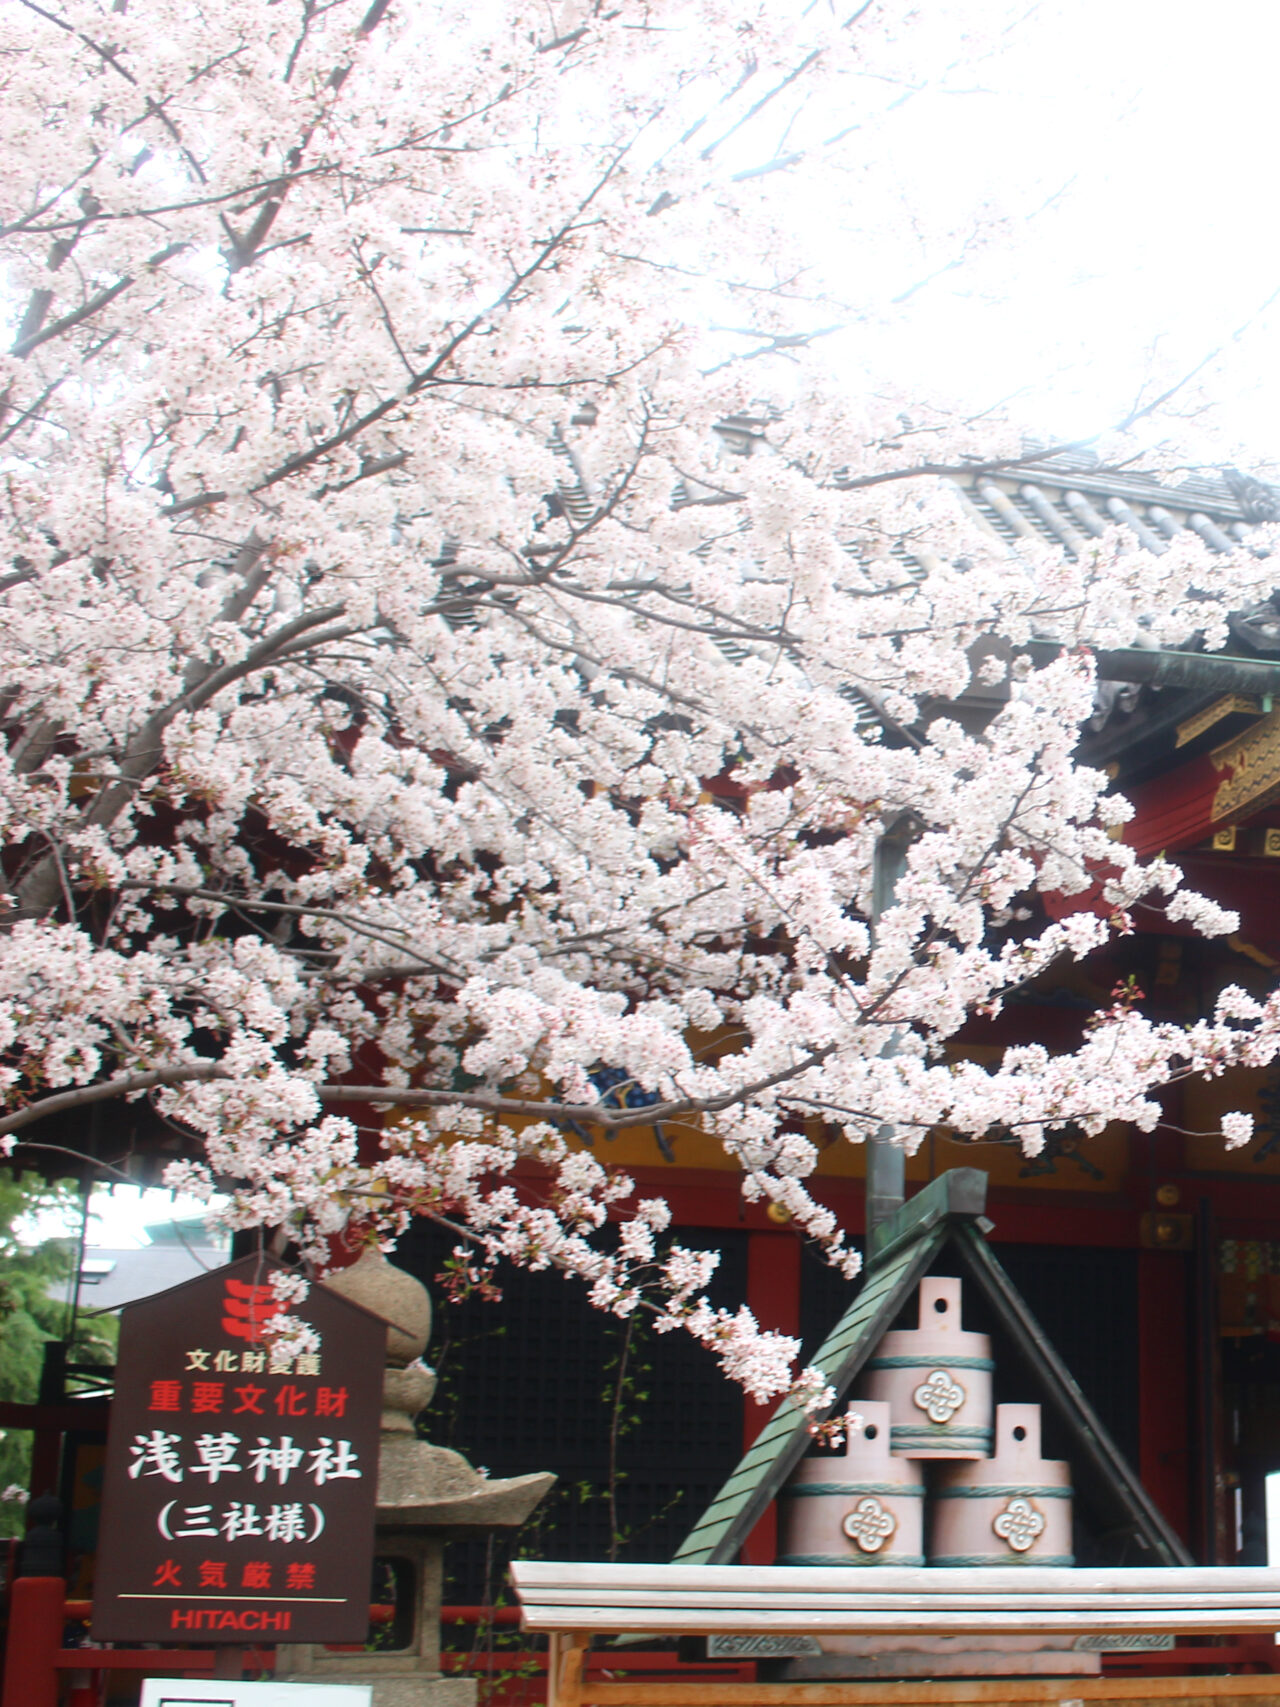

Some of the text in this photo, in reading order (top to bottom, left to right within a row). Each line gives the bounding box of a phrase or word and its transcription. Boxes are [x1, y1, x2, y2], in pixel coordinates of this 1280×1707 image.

[148, 1380, 349, 1417] 重要文化財
[128, 1430, 362, 1486] 浅草神社
[157, 1500, 326, 1543] (三社様)
[152, 1559, 316, 1590] 火気厳禁
[170, 1609, 292, 1631] HITACHI
